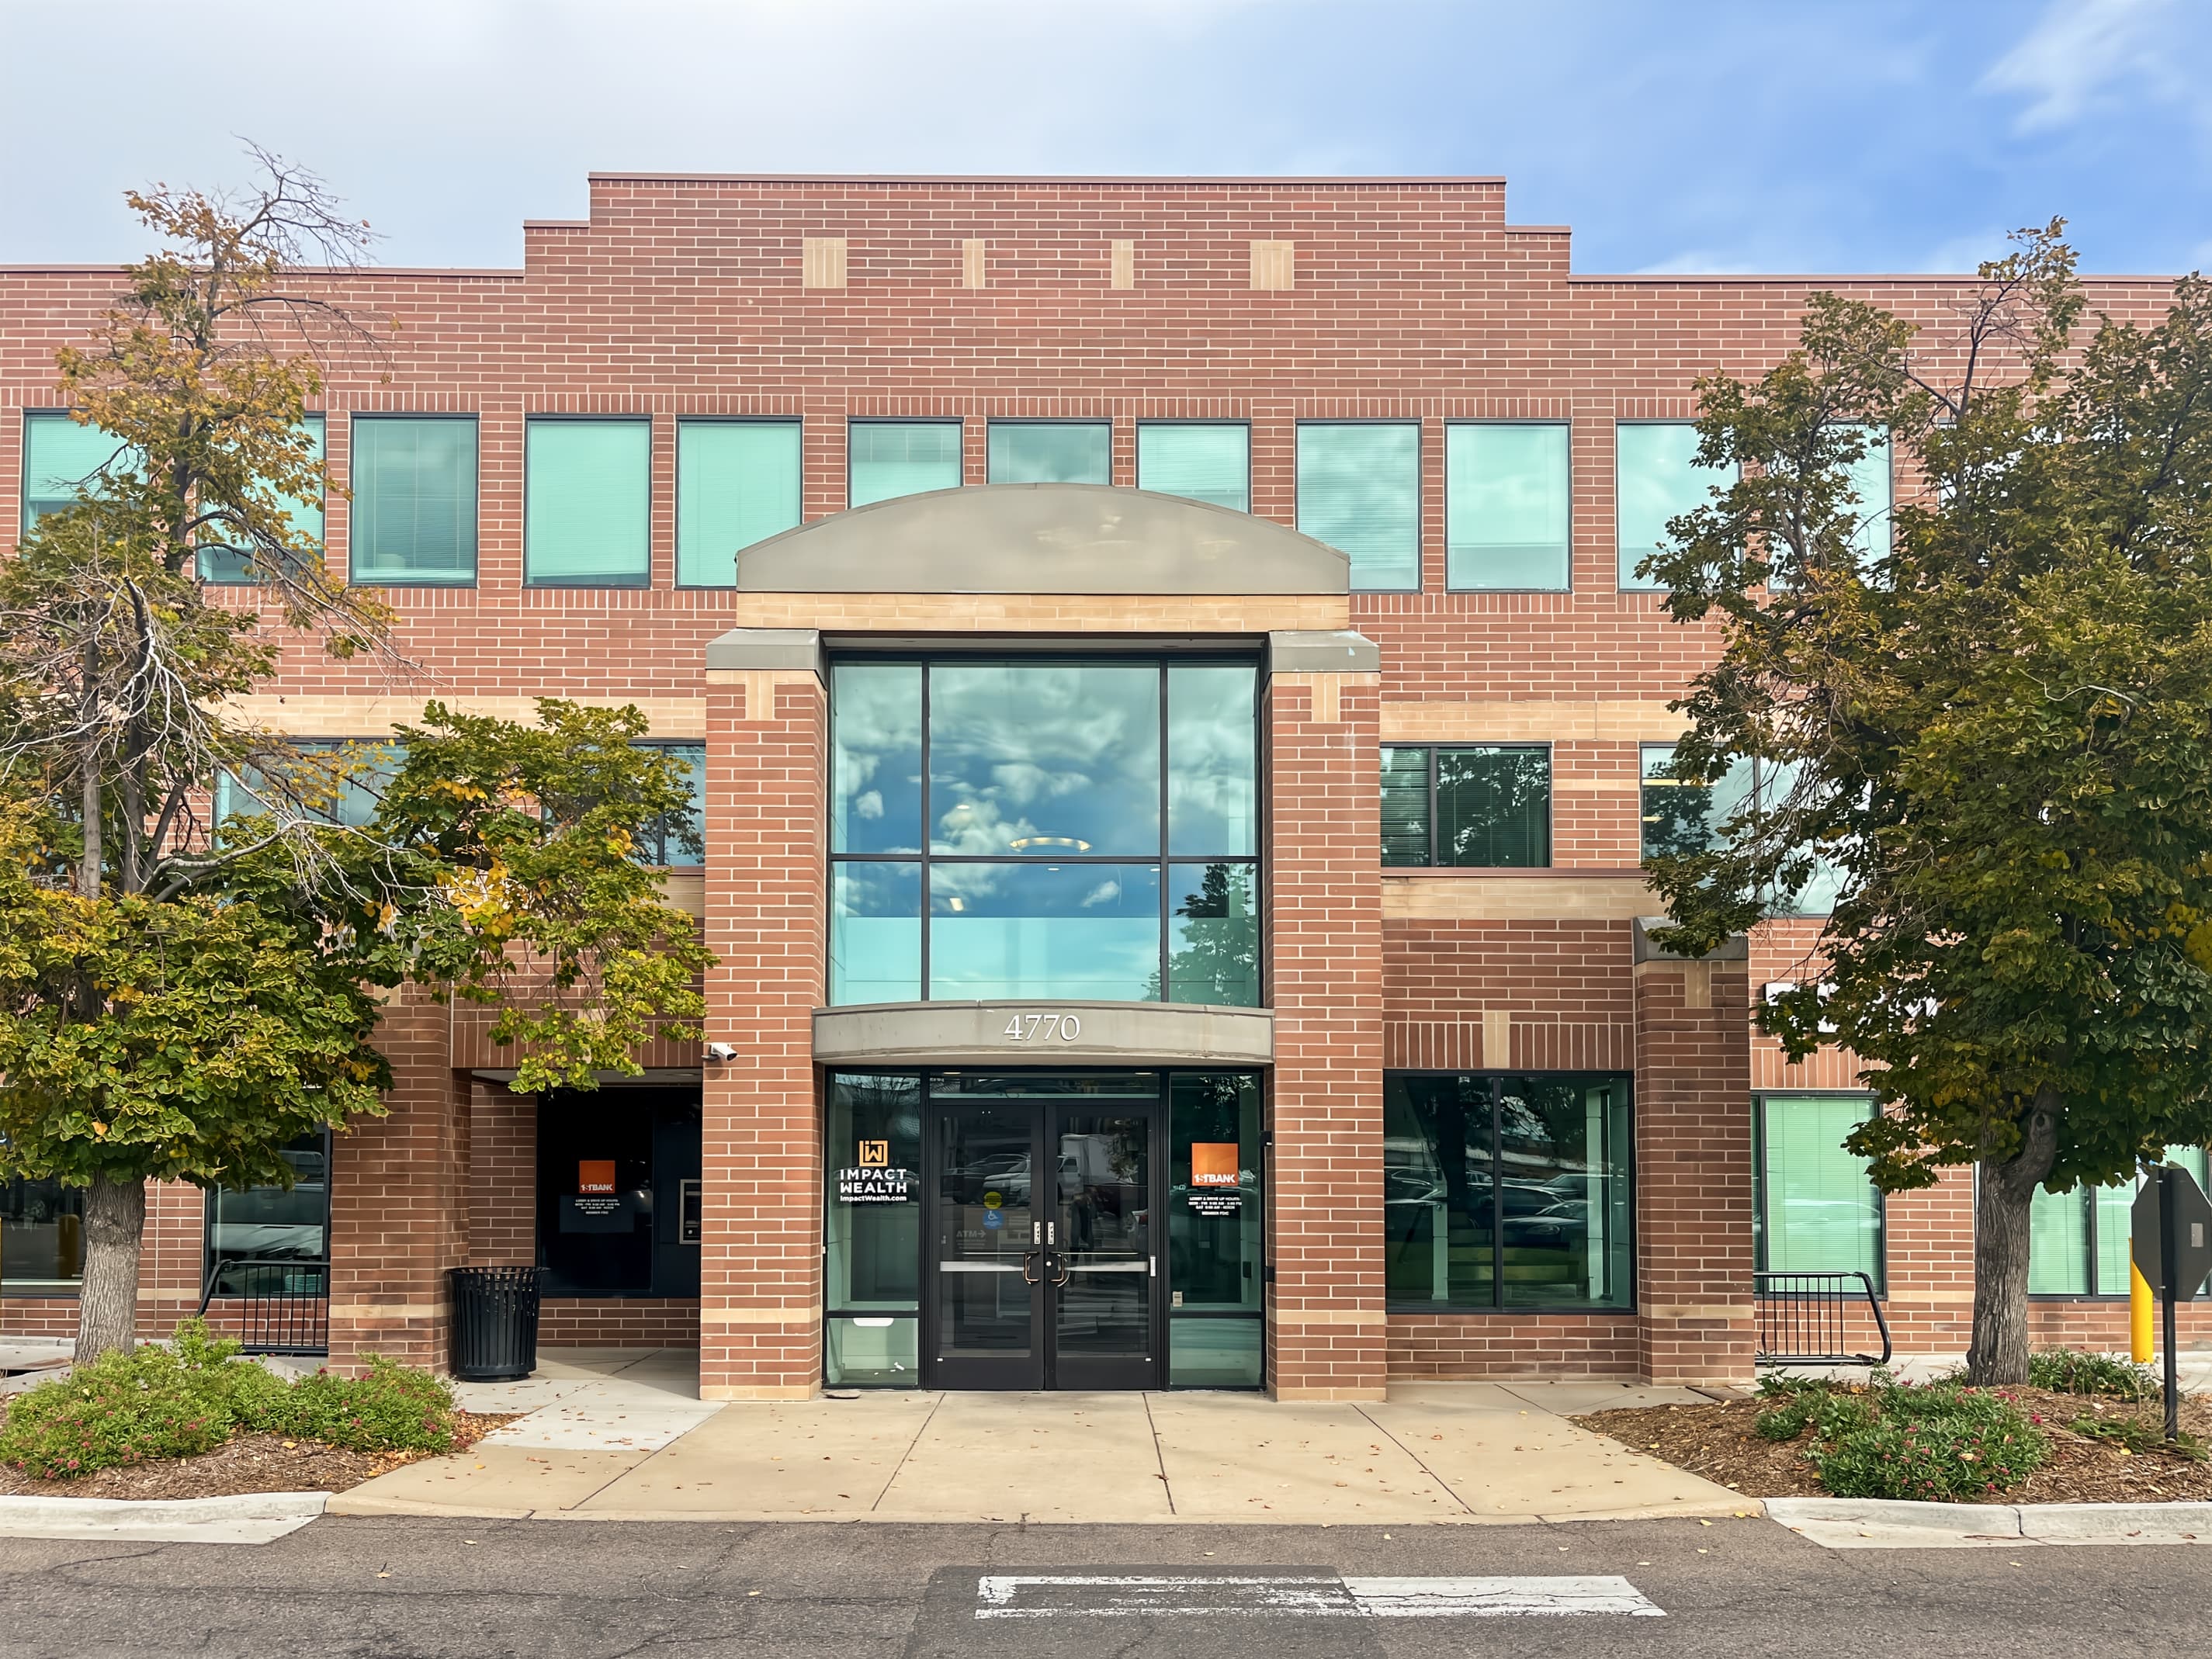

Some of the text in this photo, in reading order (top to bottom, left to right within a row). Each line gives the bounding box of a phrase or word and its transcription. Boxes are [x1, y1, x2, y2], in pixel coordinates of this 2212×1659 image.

[1004, 1014, 1080, 1041] 4770
[840, 1169, 907, 1180] IMPACT
[840, 1182, 907, 1193] WEALTH
